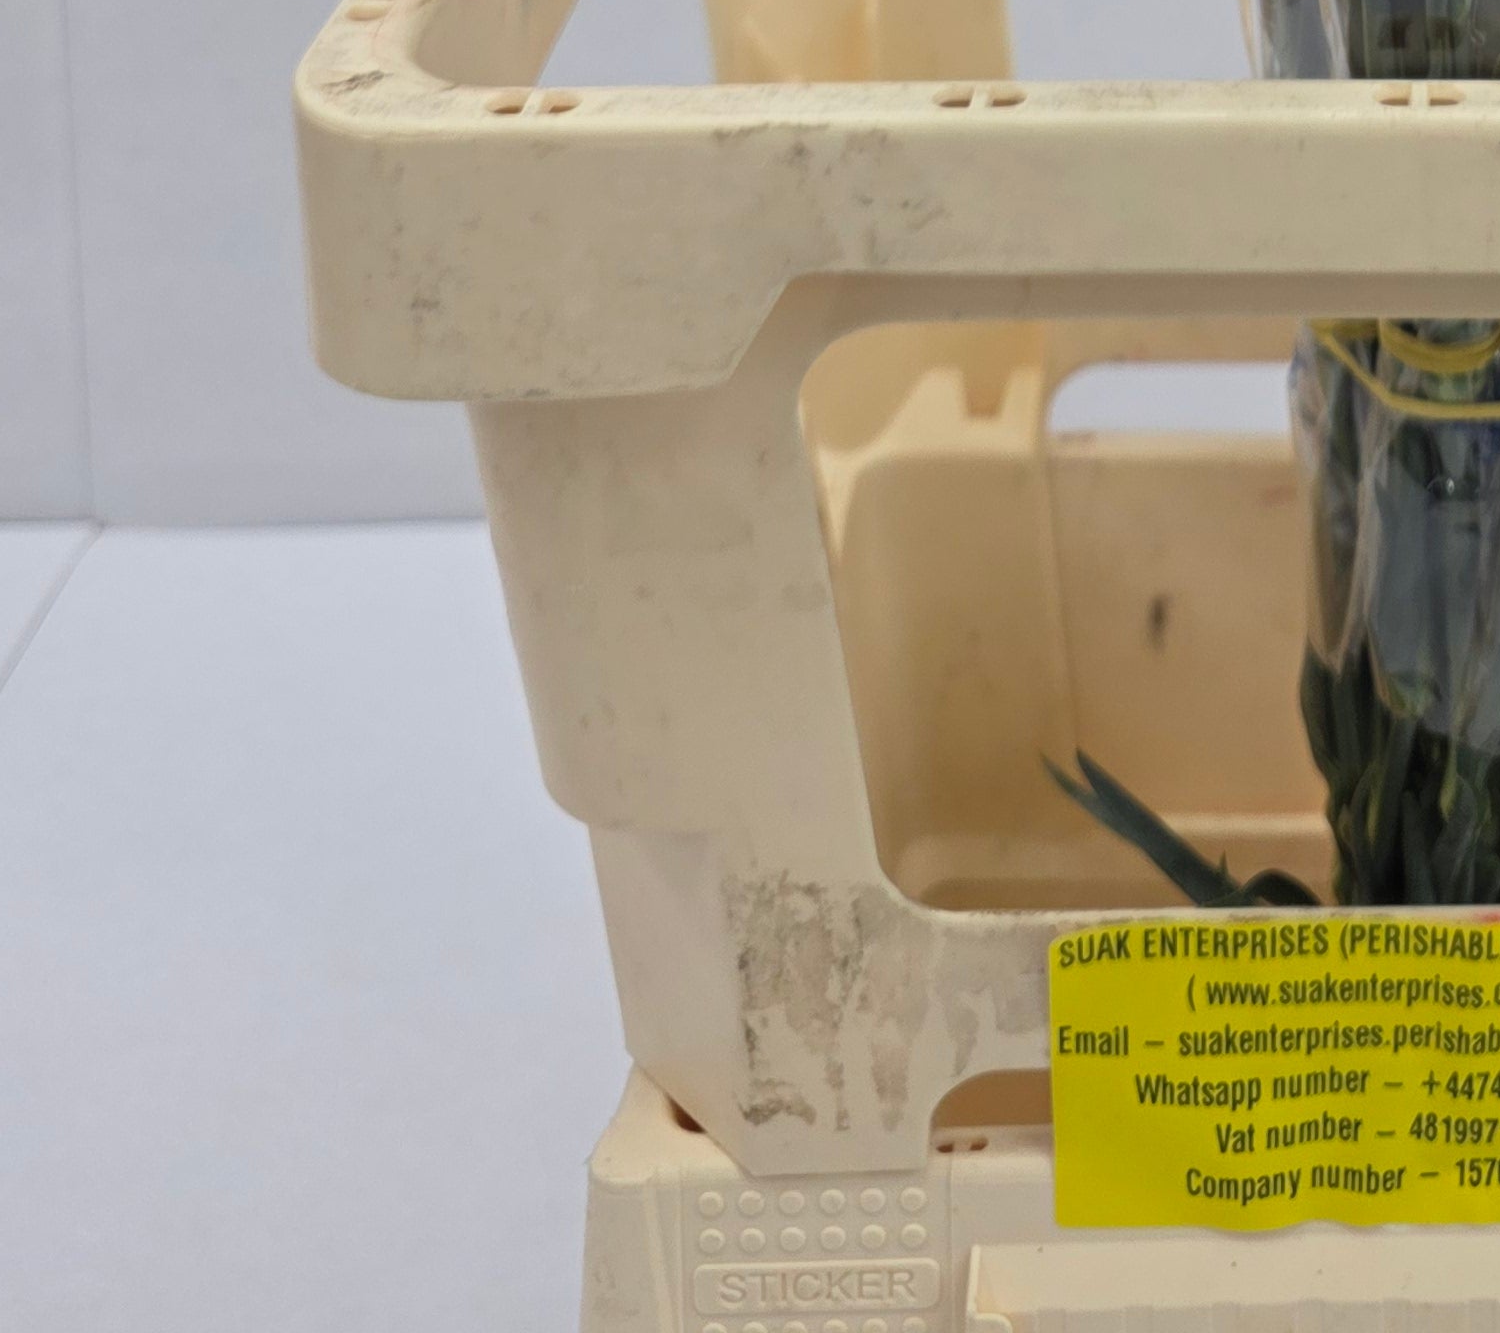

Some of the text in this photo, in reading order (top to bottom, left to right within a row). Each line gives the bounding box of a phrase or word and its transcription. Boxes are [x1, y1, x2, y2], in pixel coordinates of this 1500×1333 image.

[1059, 929, 1131, 970] SUAK
[1144, 924, 1329, 960] ENTERPRISES
[1058, 1024, 1130, 1057] Email
[1134, 1073, 1262, 1112] Whatsapp
[1272, 1065, 1371, 1100] number
[1215, 1123, 1256, 1155] Vat
[1265, 1110, 1363, 1151] number
[1185, 1167, 1302, 1208] Company
[1311, 1163, 1407, 1195] number
[718, 1266, 919, 1304] STICKER
